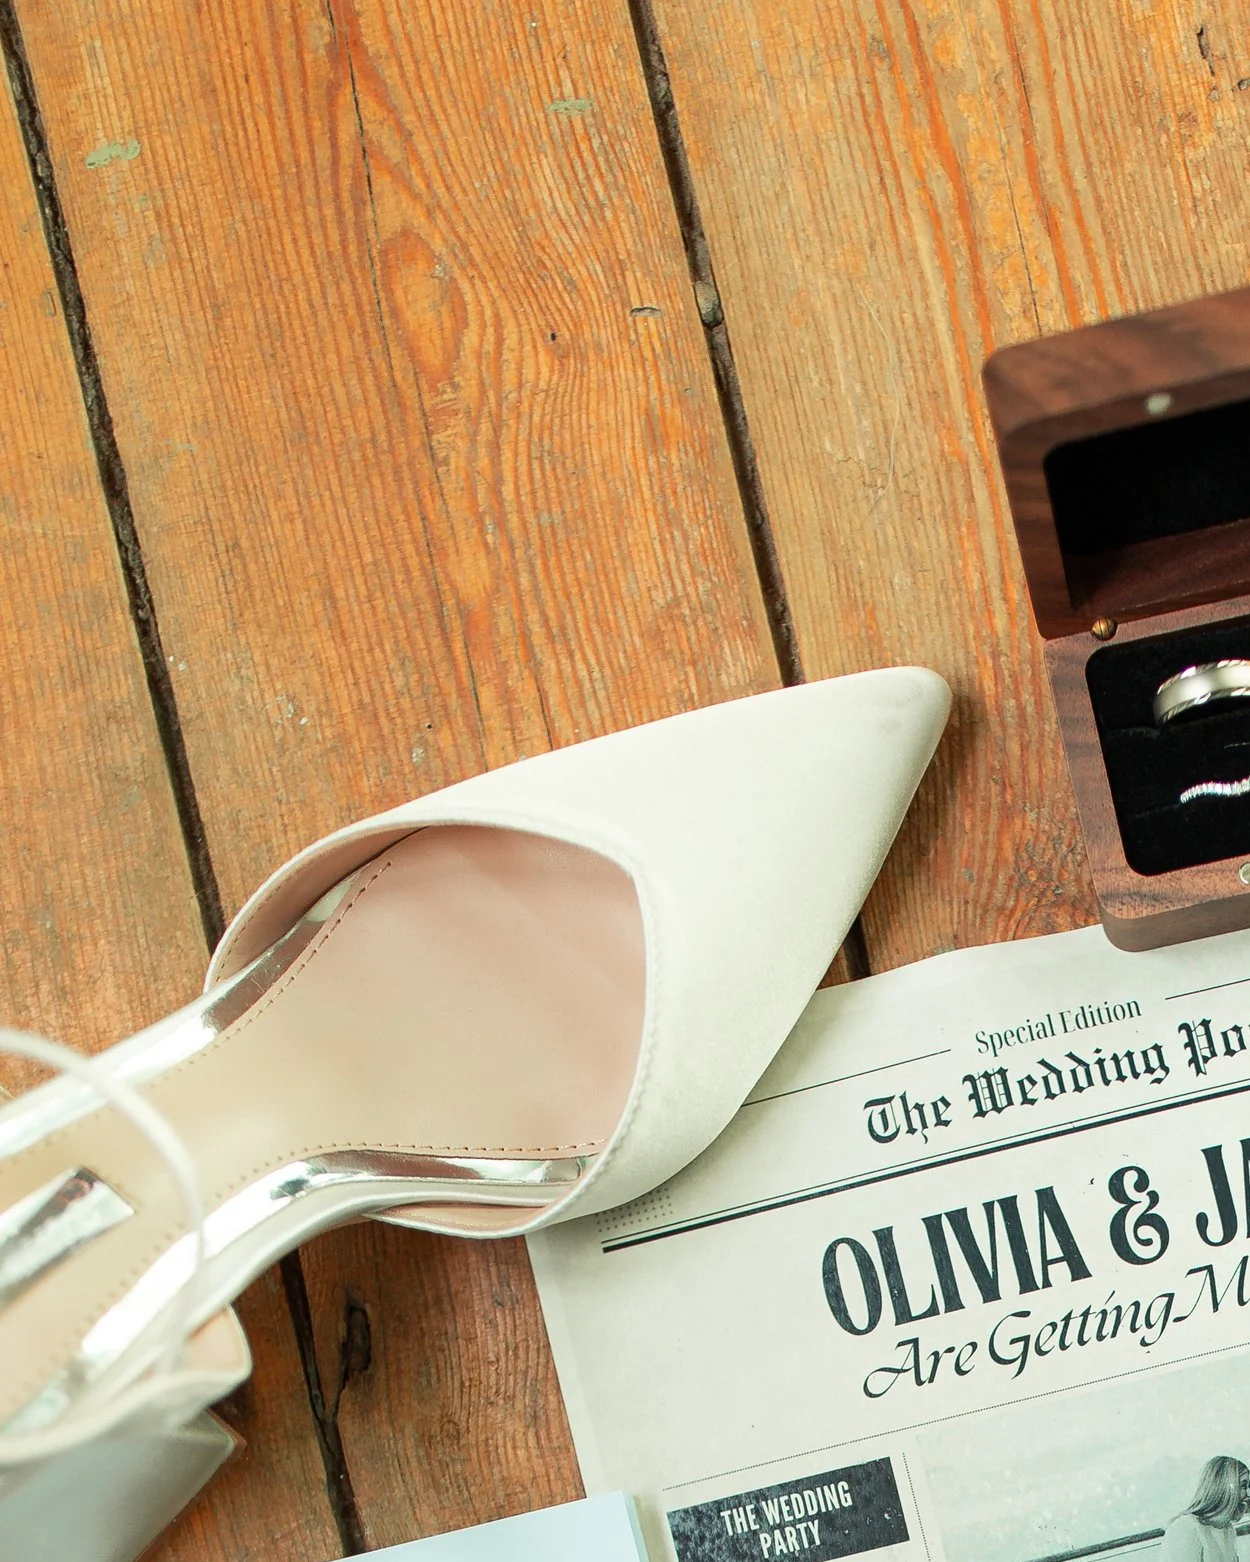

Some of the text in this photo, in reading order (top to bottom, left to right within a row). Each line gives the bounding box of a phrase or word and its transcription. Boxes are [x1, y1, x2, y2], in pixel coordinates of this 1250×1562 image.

[975, 1000, 1142, 1058] Special Edition
[863, 1090, 953, 1145] The
[961, 1042, 1170, 1119] Wedding
[821, 1185, 1093, 1336] OLIVIA
[1108, 1165, 1170, 1266] &
[862, 1336, 978, 1399] Are
[988, 1290, 1174, 1380] Getting
[719, 1480, 853, 1537] THE WEDDING
[758, 1519, 821, 1559] PARTY
